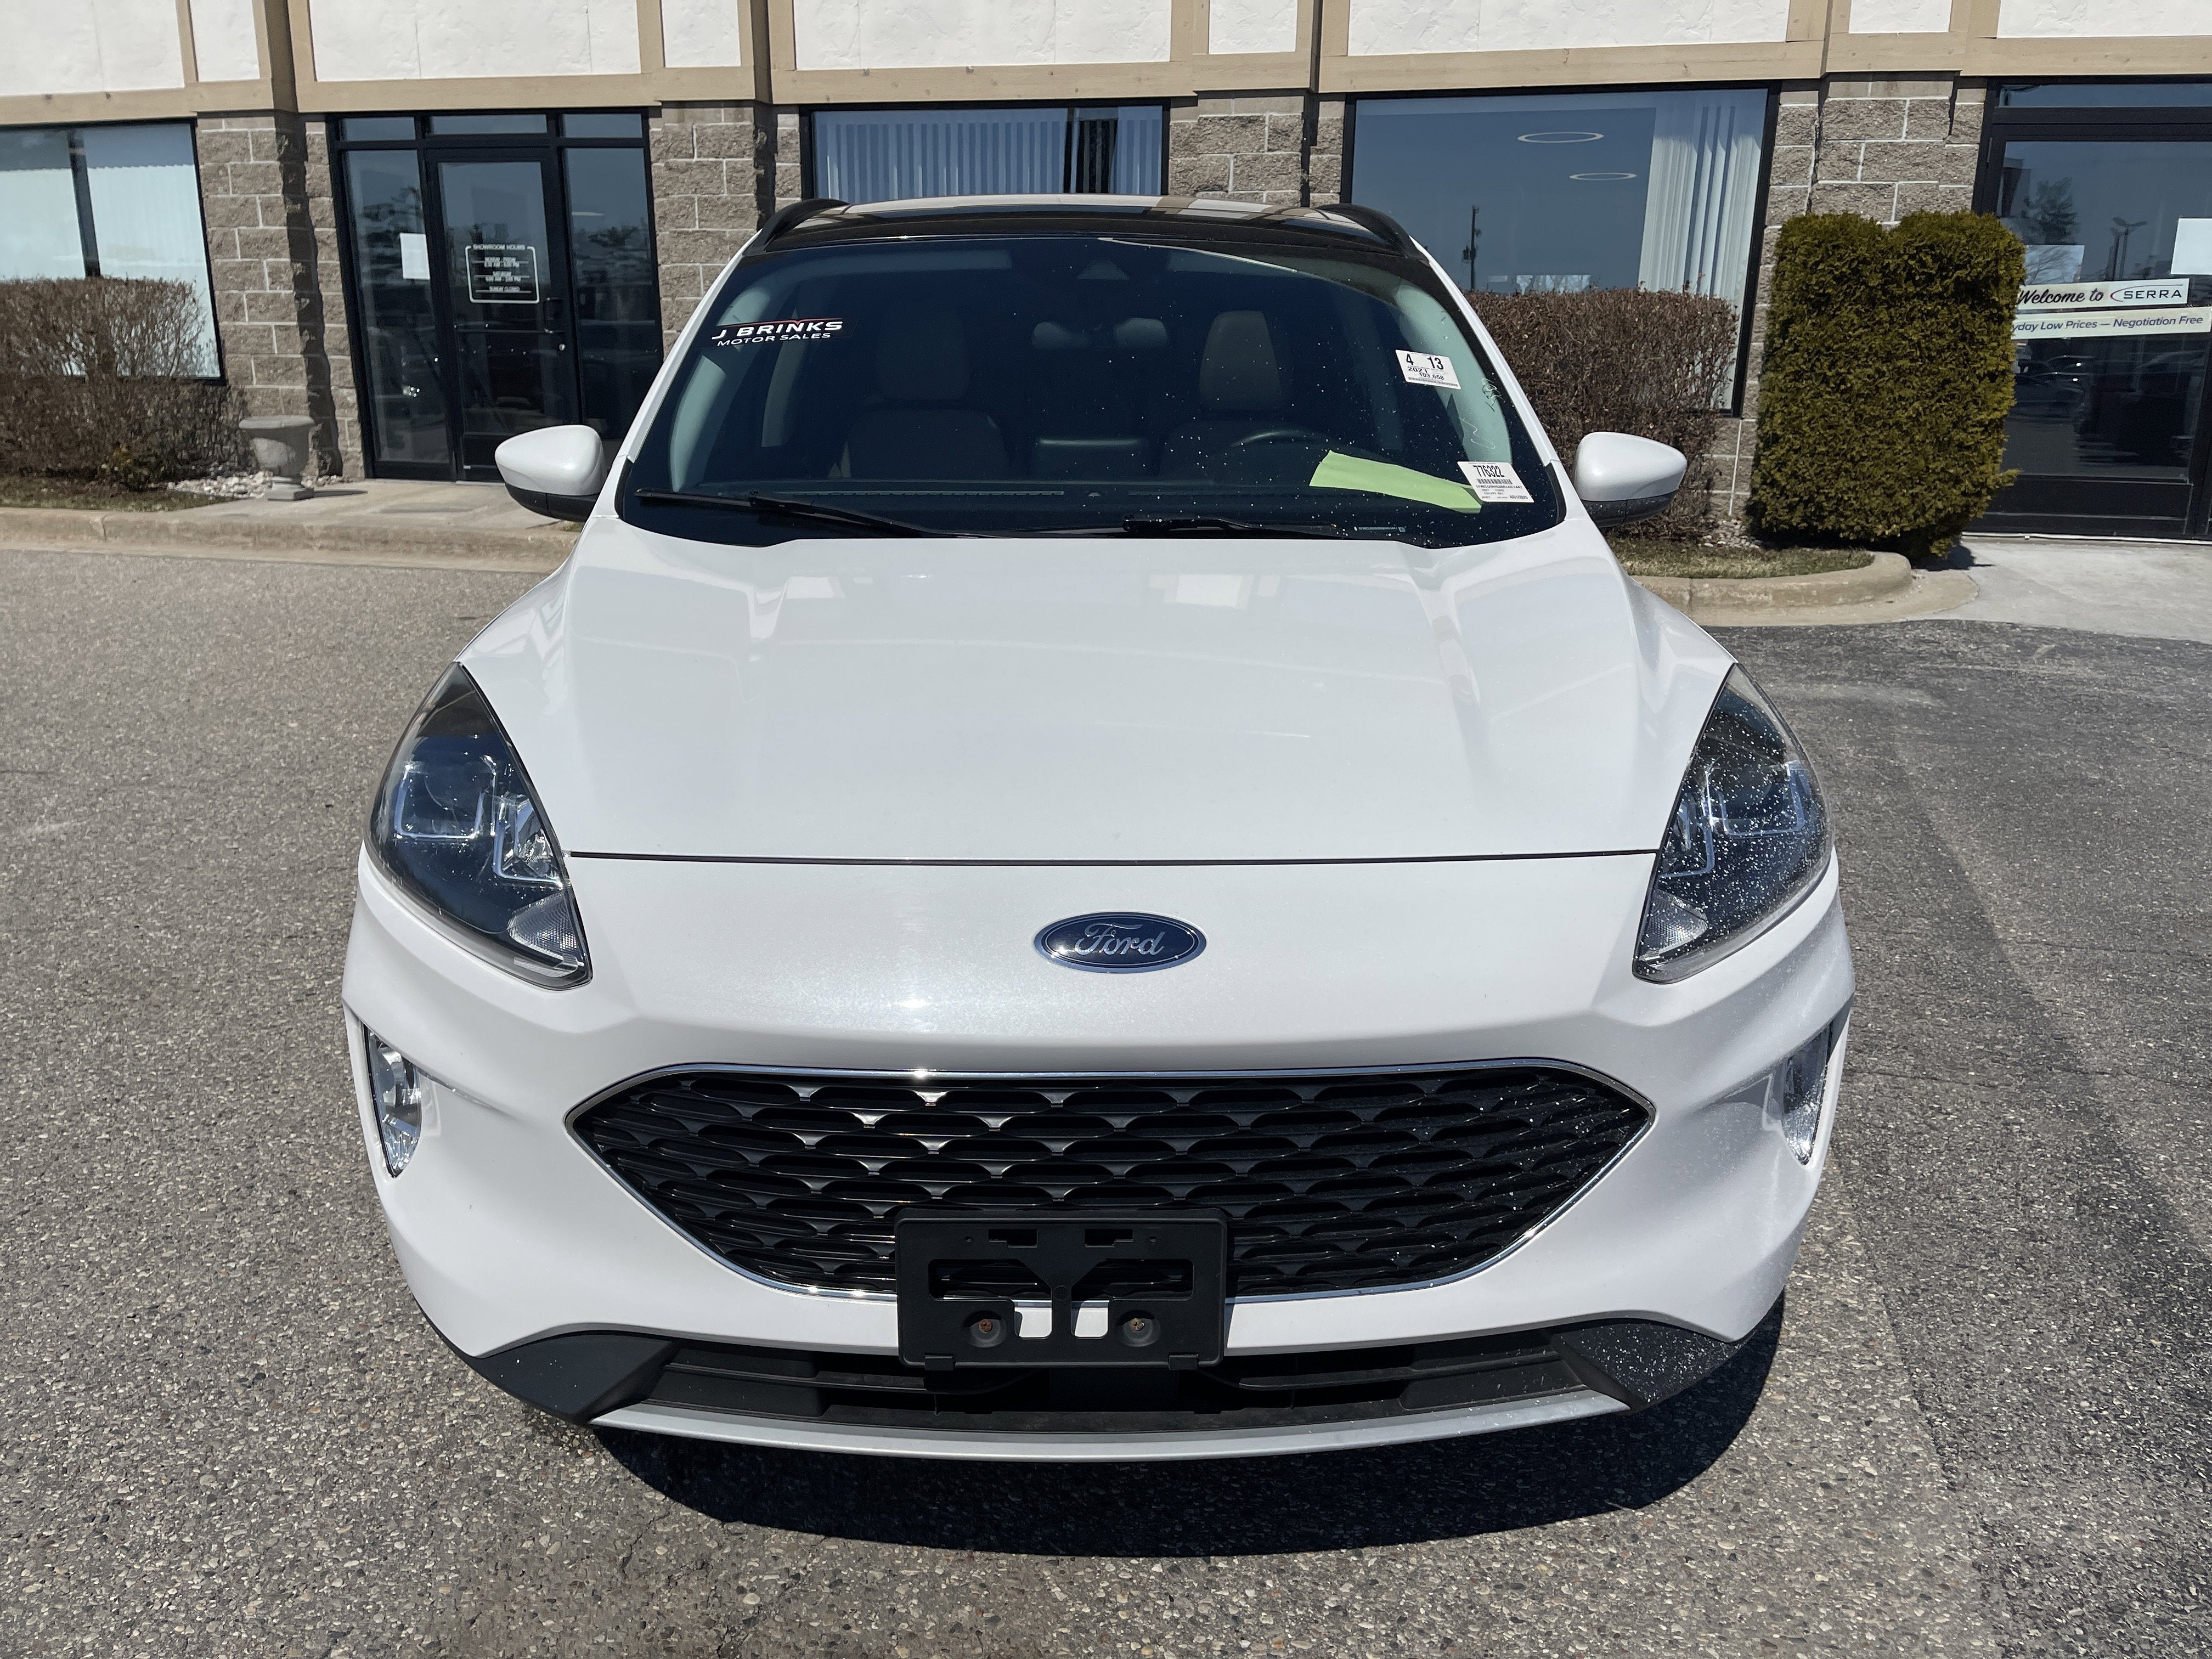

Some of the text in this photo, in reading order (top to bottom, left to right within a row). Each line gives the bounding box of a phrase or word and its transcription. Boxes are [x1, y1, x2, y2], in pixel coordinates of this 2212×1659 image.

[2017, 288, 2182, 304] Welcome to SERRA
[711, 321, 843, 340] J BRINKS
[2041, 321, 2063, 330] Low
[2066, 320, 2097, 329] Prices
[2113, 317, 2176, 329] Negotiation
[2179, 316, 2203, 325] Free
[717, 332, 831, 346] MOTOR SALES
[1406, 353, 1414, 365] 4
[1427, 357, 1444, 370] 13
[1472, 465, 1505, 477] 776322
[1075, 923, 1166, 956] Ford
